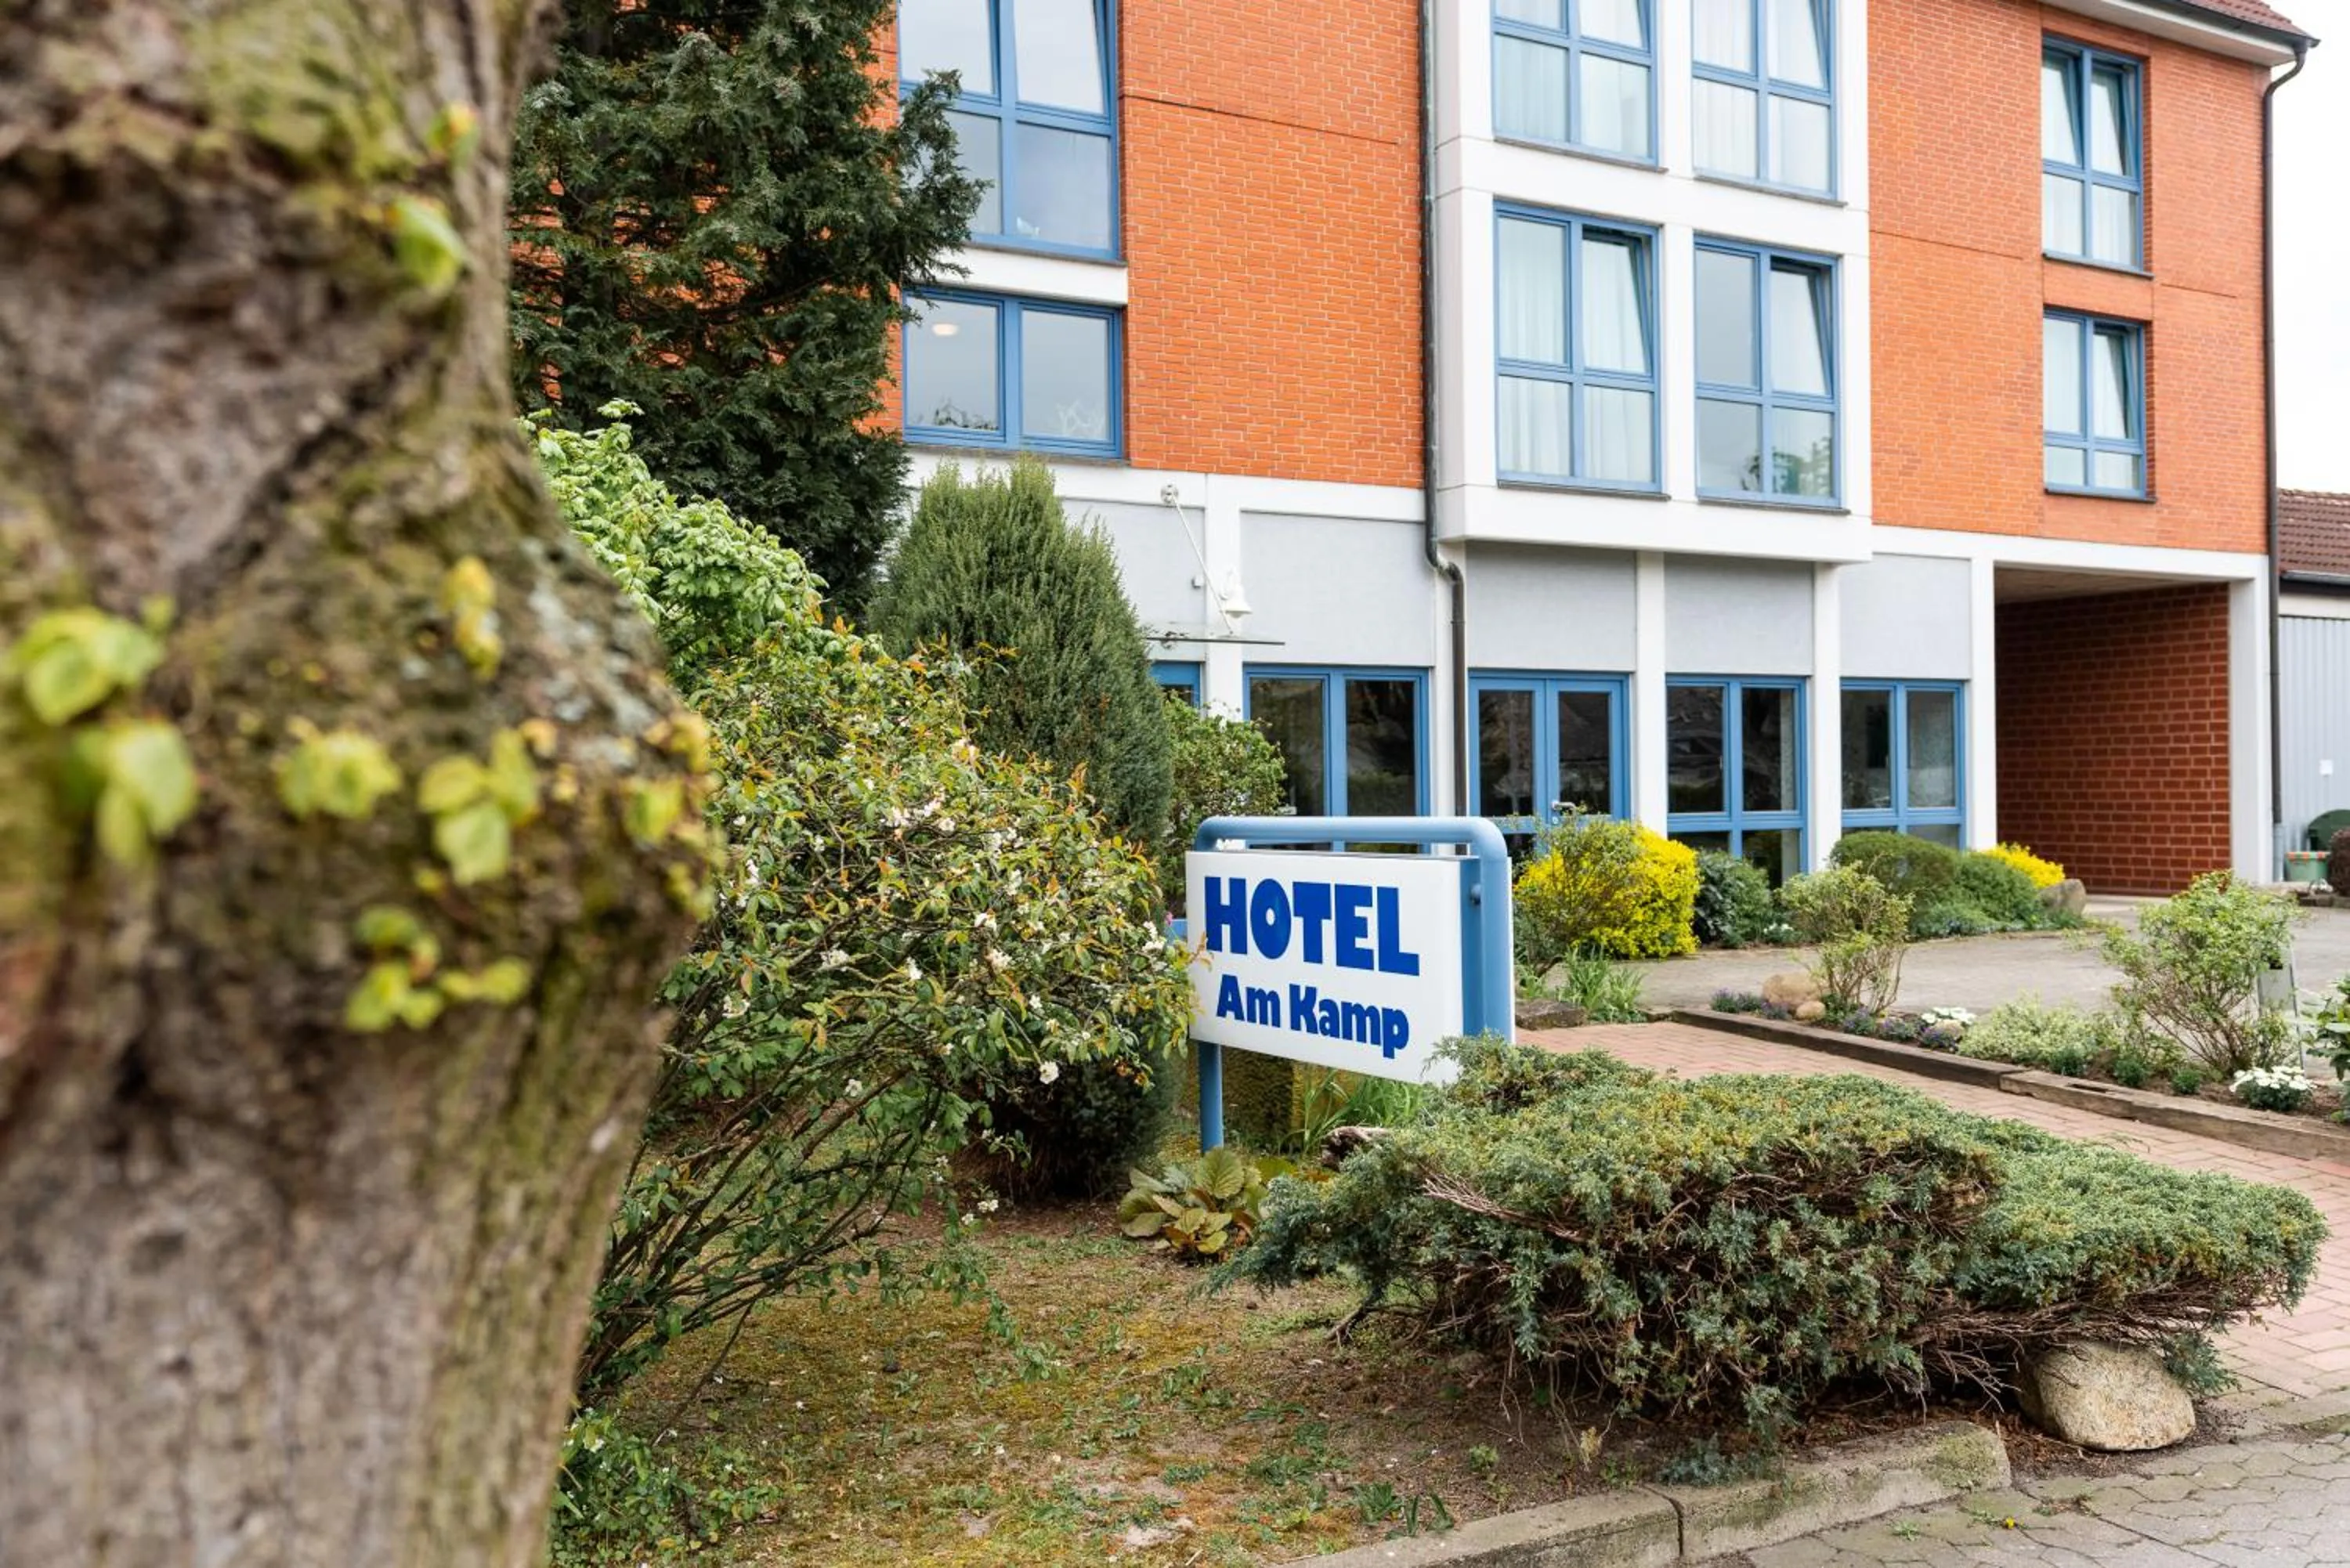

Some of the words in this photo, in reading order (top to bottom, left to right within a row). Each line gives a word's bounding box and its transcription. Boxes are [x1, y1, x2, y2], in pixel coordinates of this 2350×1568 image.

[1204, 876, 1420, 977] HOTEL
[1217, 974, 1281, 1028] Am
[1289, 983, 1410, 1060] Kamp
